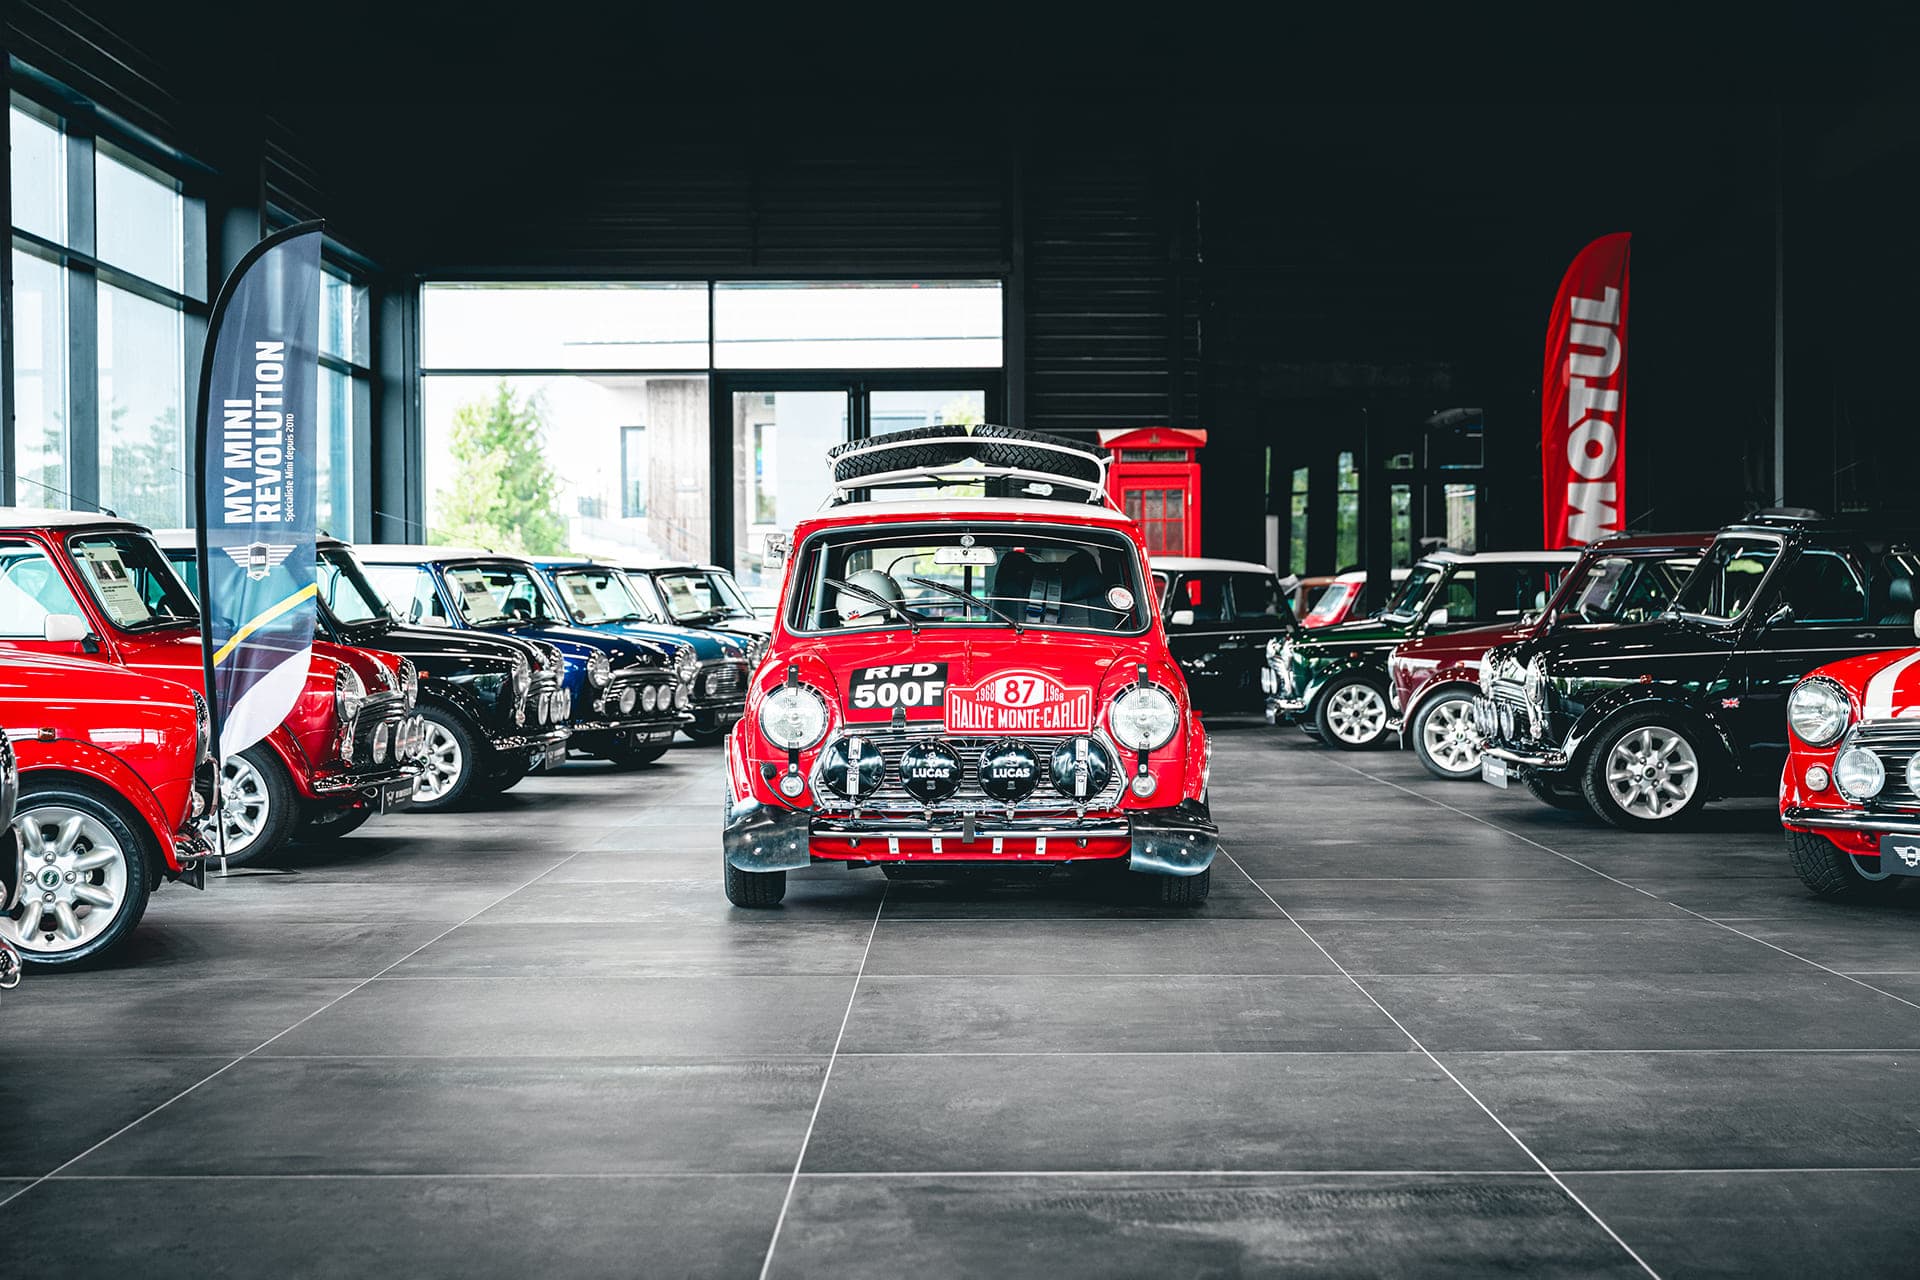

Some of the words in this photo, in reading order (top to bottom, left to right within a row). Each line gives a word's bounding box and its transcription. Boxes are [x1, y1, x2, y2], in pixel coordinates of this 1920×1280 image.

[286, 413, 295, 433] 2010
[1567, 286, 1621, 543] MOTUL
[223, 399, 253, 469] MINI
[255, 341, 285, 523] REVOLUTION
[285, 434, 296, 460] depuis
[285, 461, 294, 479] Mini
[223, 475, 253, 524] MY
[285, 480, 296, 523] Spécialiste
[864, 663, 938, 681] RFD
[853, 681, 945, 709] 500F
[975, 682, 995, 702] 1968
[1004, 679, 1036, 704] 87
[1045, 682, 1064, 702] 1968
[951, 693, 994, 729] RALLYE
[998, 693, 1087, 729] MONTE-CARLO
[912, 767, 950, 778] LUCAS
[992, 767, 1031, 778] LUCAS
